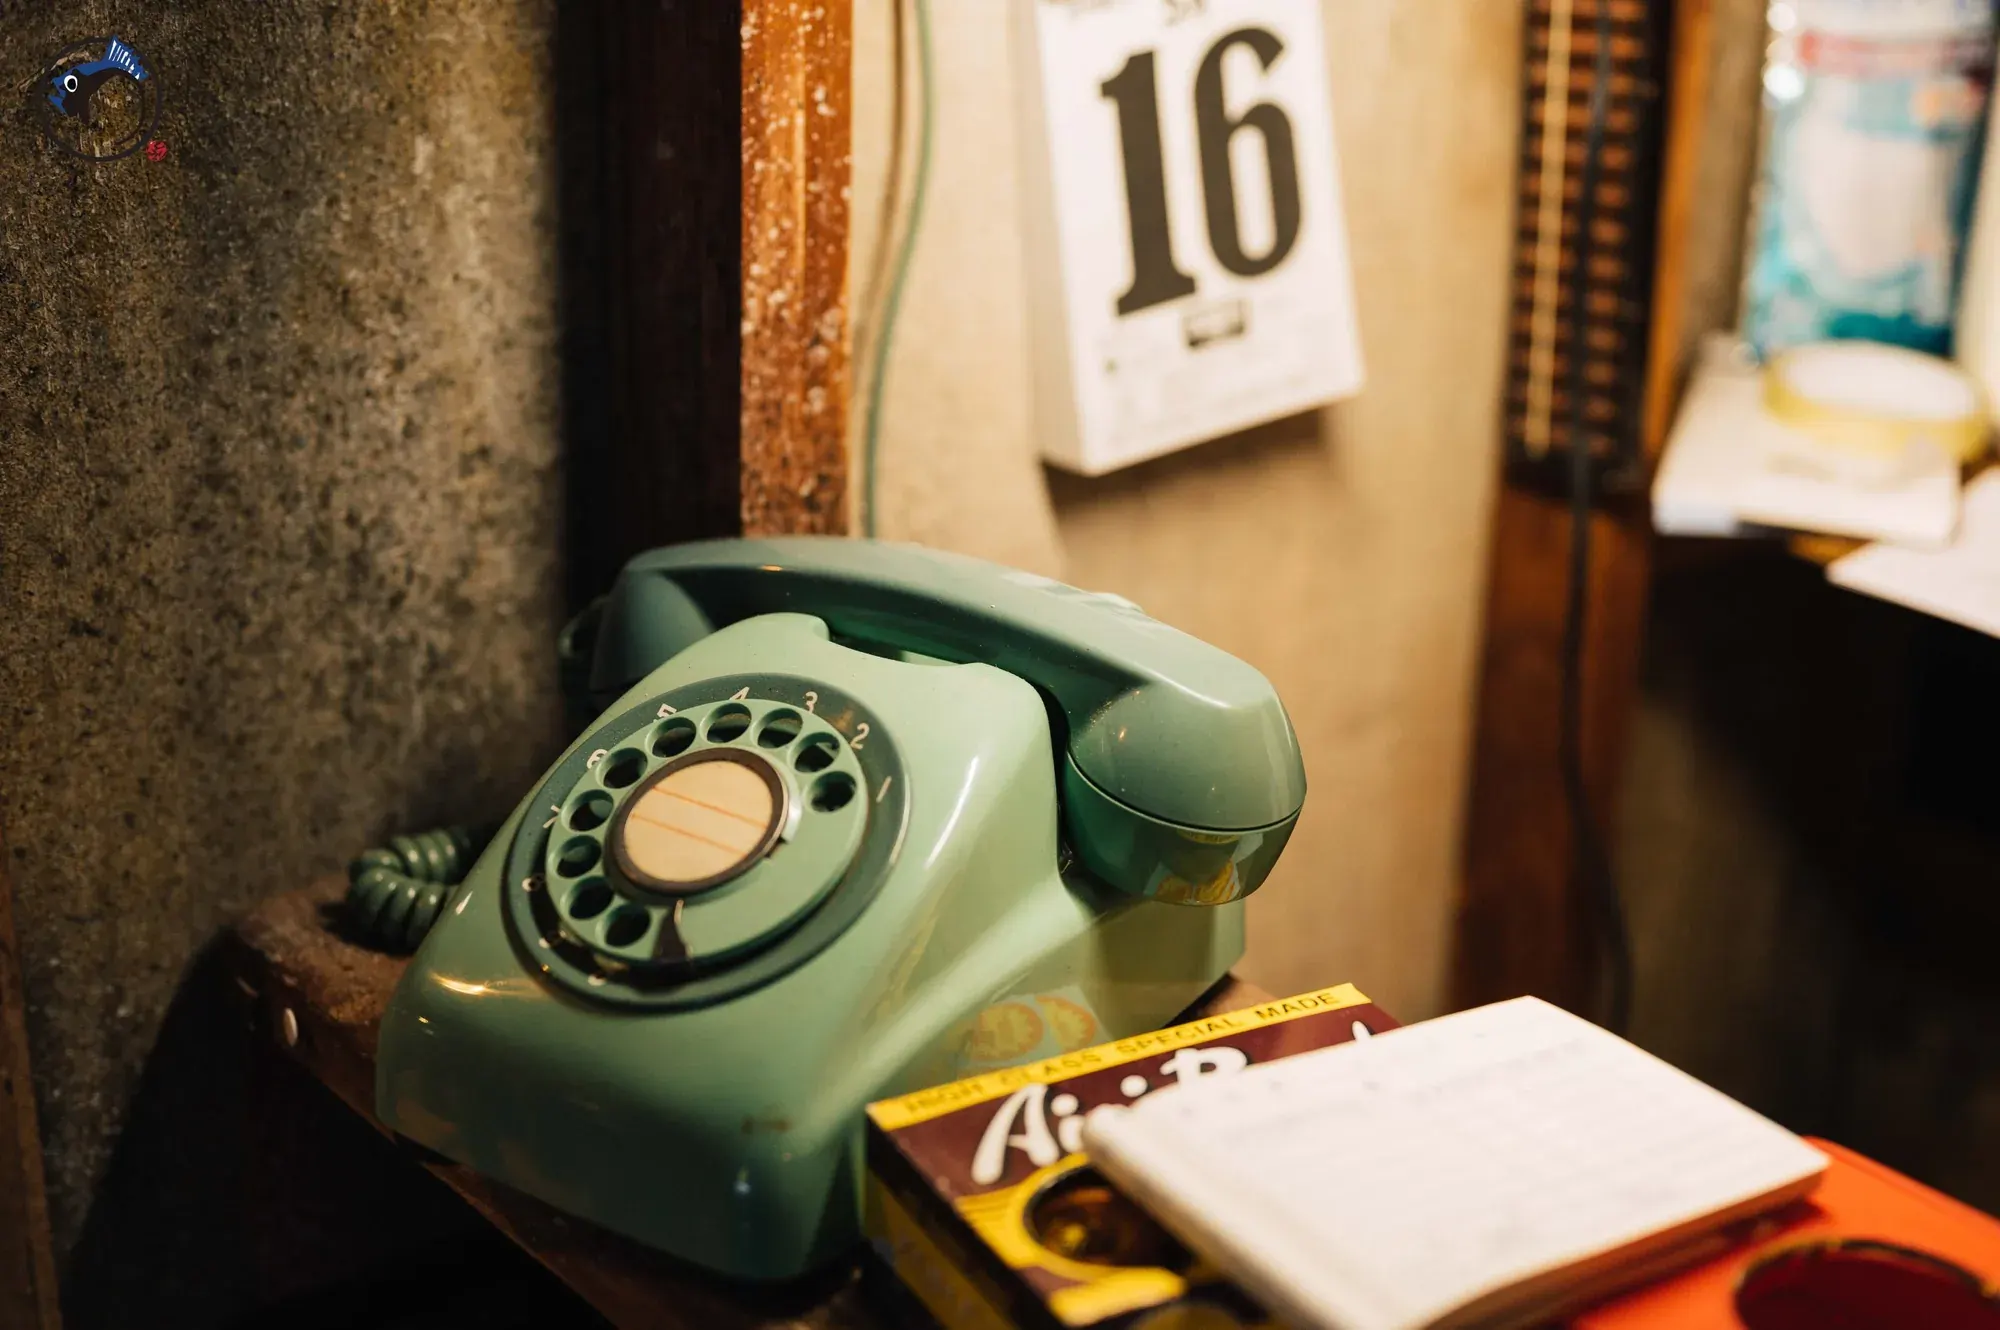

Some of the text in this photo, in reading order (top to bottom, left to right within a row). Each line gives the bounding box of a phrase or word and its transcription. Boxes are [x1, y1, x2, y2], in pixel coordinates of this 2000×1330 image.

[1099, 26, 1304, 317] 16
[804, 690, 819, 714] 3
[850, 722, 870, 750] 2
[1115, 1017, 1242, 1056] SPECIAL
[1253, 991, 1341, 1021] MADE
